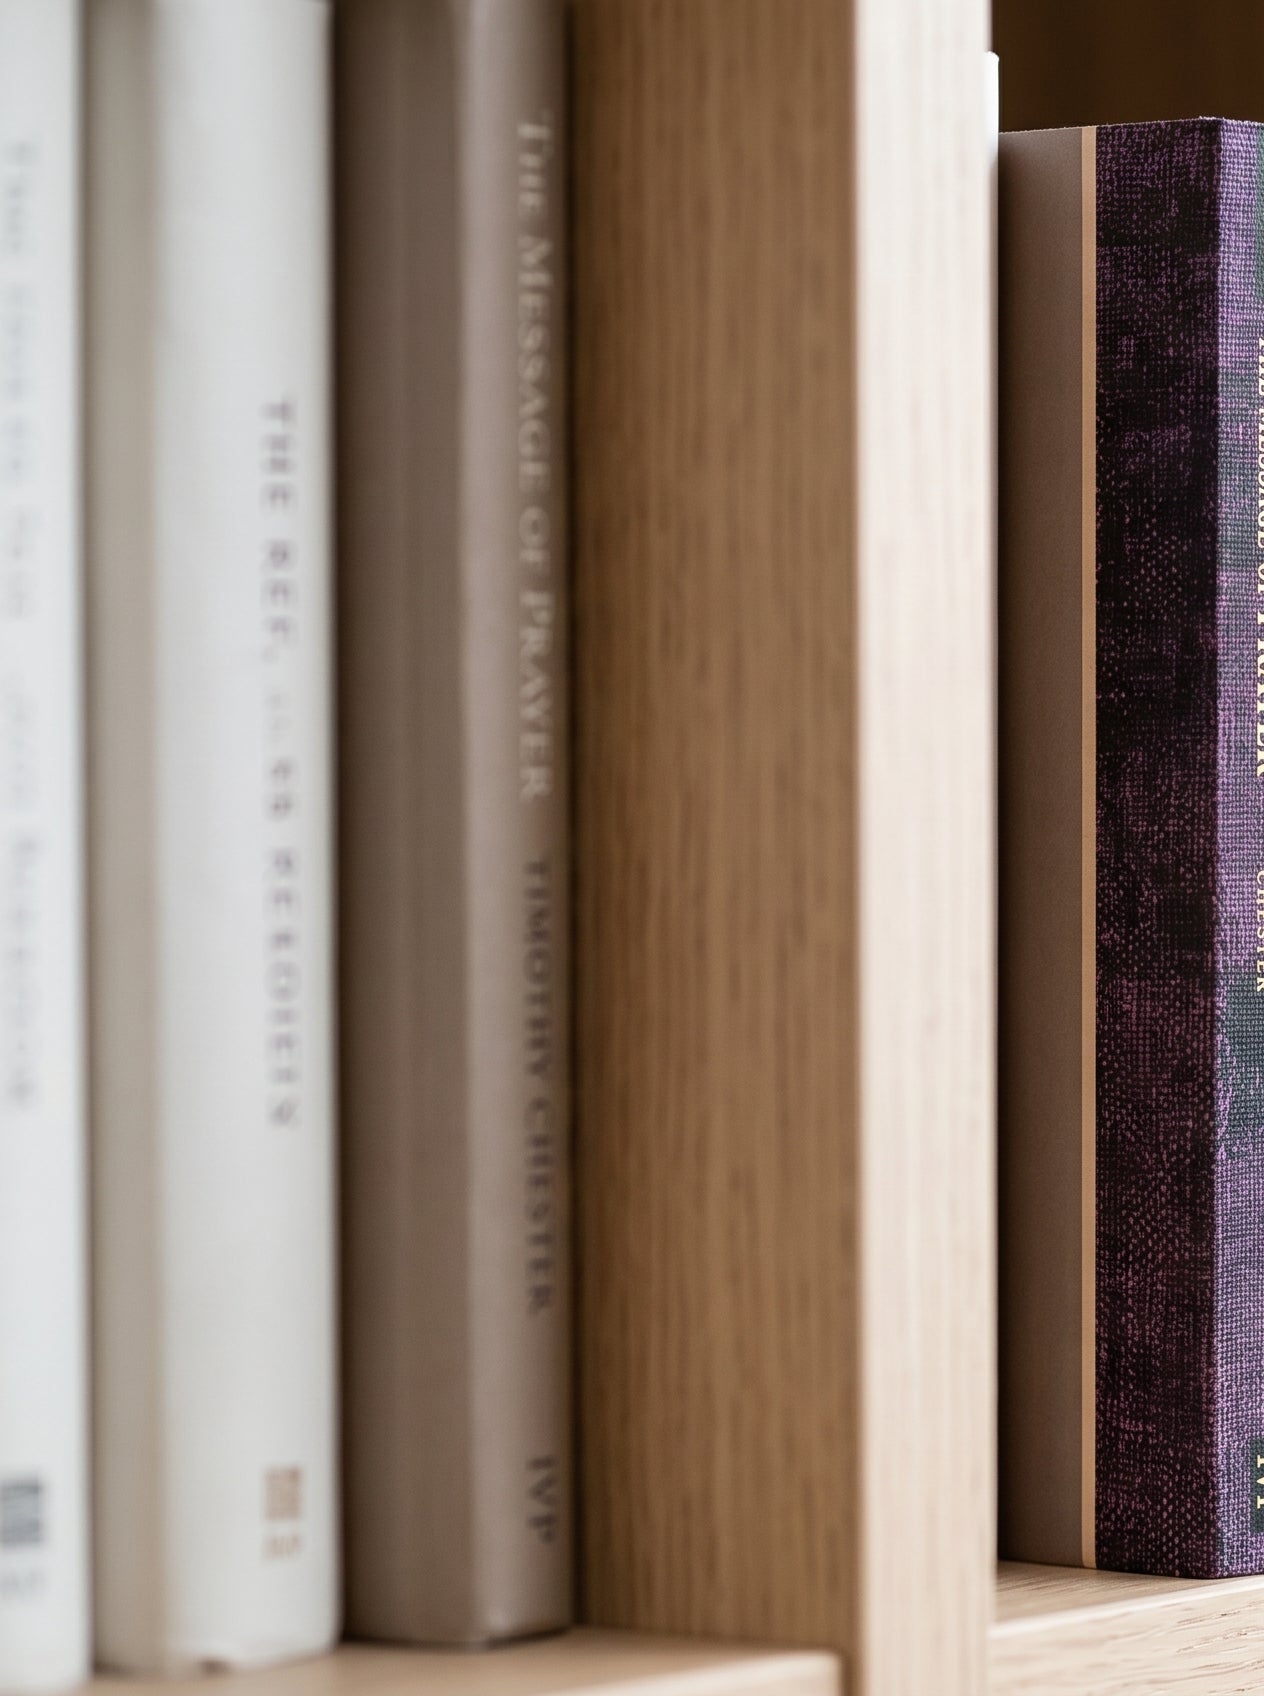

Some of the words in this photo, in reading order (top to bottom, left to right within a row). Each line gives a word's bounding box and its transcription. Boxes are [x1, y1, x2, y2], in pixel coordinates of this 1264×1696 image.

[517, 233, 553, 493] MESSAGE
[518, 590, 554, 803] PRAYER
[522, 855, 557, 1079] TIMOTHY
[522, 1096, 557, 1318] CHESTER
[525, 1455, 559, 1546] IVP
